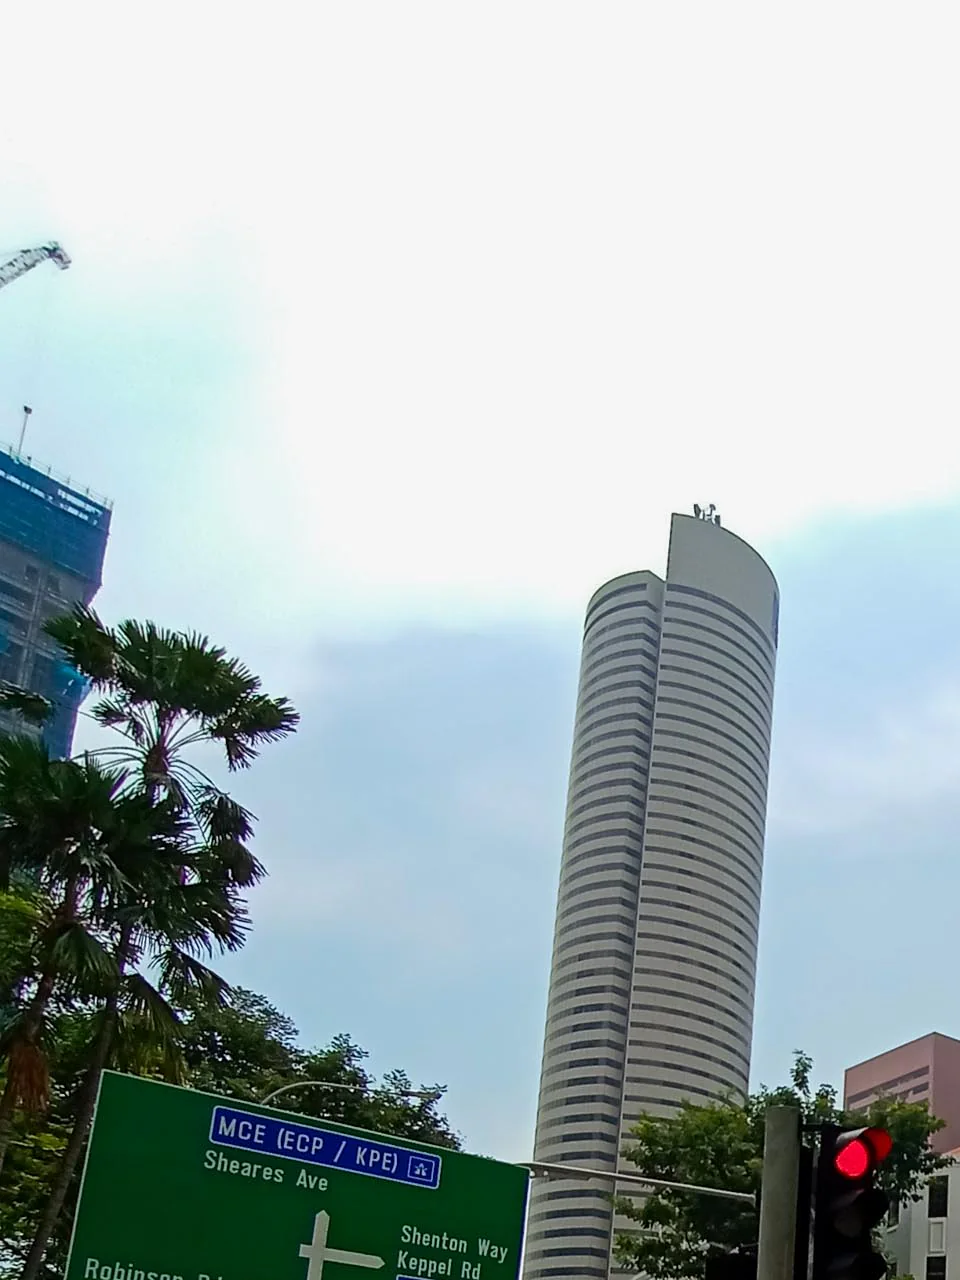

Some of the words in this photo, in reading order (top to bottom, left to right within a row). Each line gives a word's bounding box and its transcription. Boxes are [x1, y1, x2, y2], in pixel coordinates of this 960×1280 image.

[218, 1115, 266, 1144] MCE
[276, 1127, 324, 1155] (ECP
[333, 1140, 347, 1163] /
[356, 1146, 398, 1174] KPE)
[204, 1149, 284, 1183] Sheares
[296, 1168, 328, 1191] Ave
[401, 1225, 467, 1253] Shenton
[478, 1237, 508, 1264] Way
[397, 1250, 453, 1277] Keppel
[461, 1261, 481, 1280] Rd
